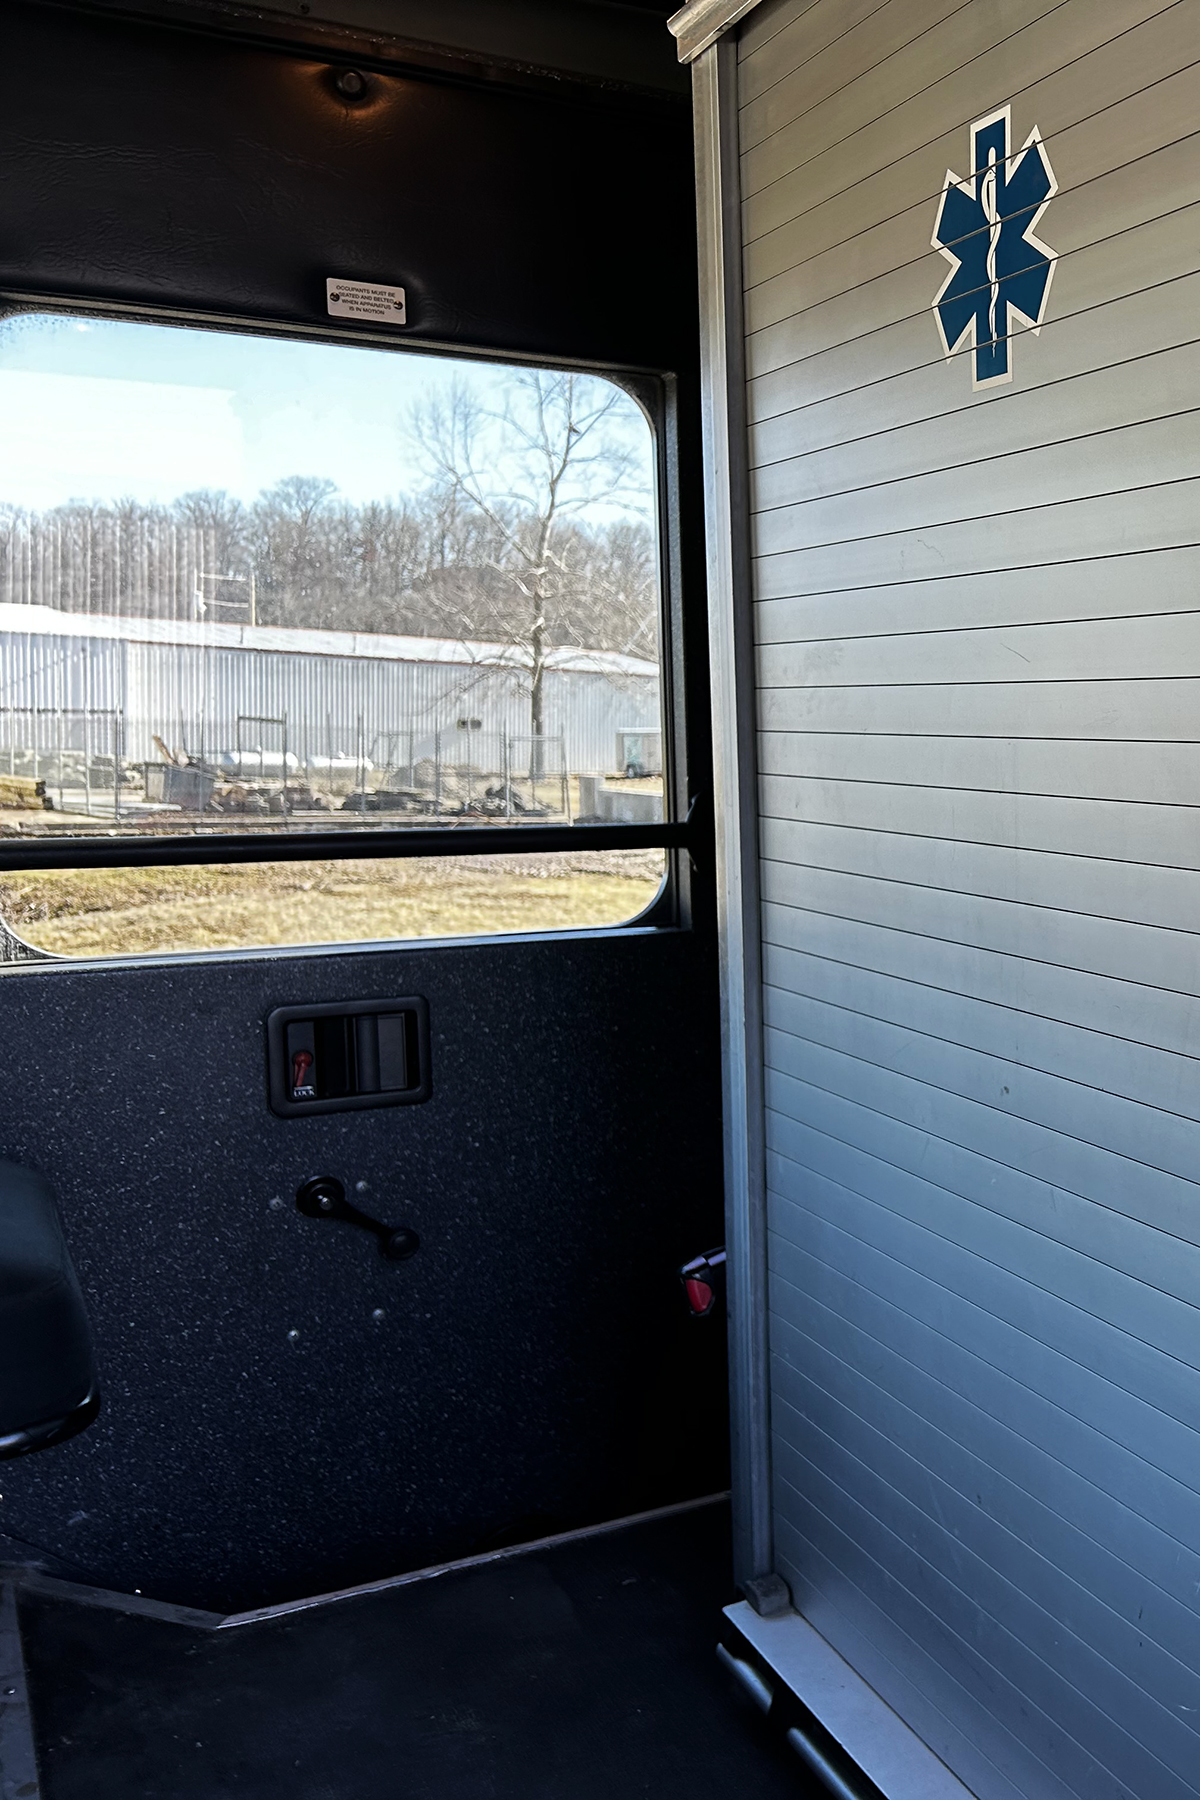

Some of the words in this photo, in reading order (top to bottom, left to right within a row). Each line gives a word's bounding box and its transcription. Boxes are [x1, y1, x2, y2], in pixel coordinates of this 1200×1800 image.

[336, 285, 370, 294] OCCUPANTS
[374, 296, 394, 304] BELTED
[360, 300, 392, 310] APPARATUS
[363, 307, 385, 315] MOTION
